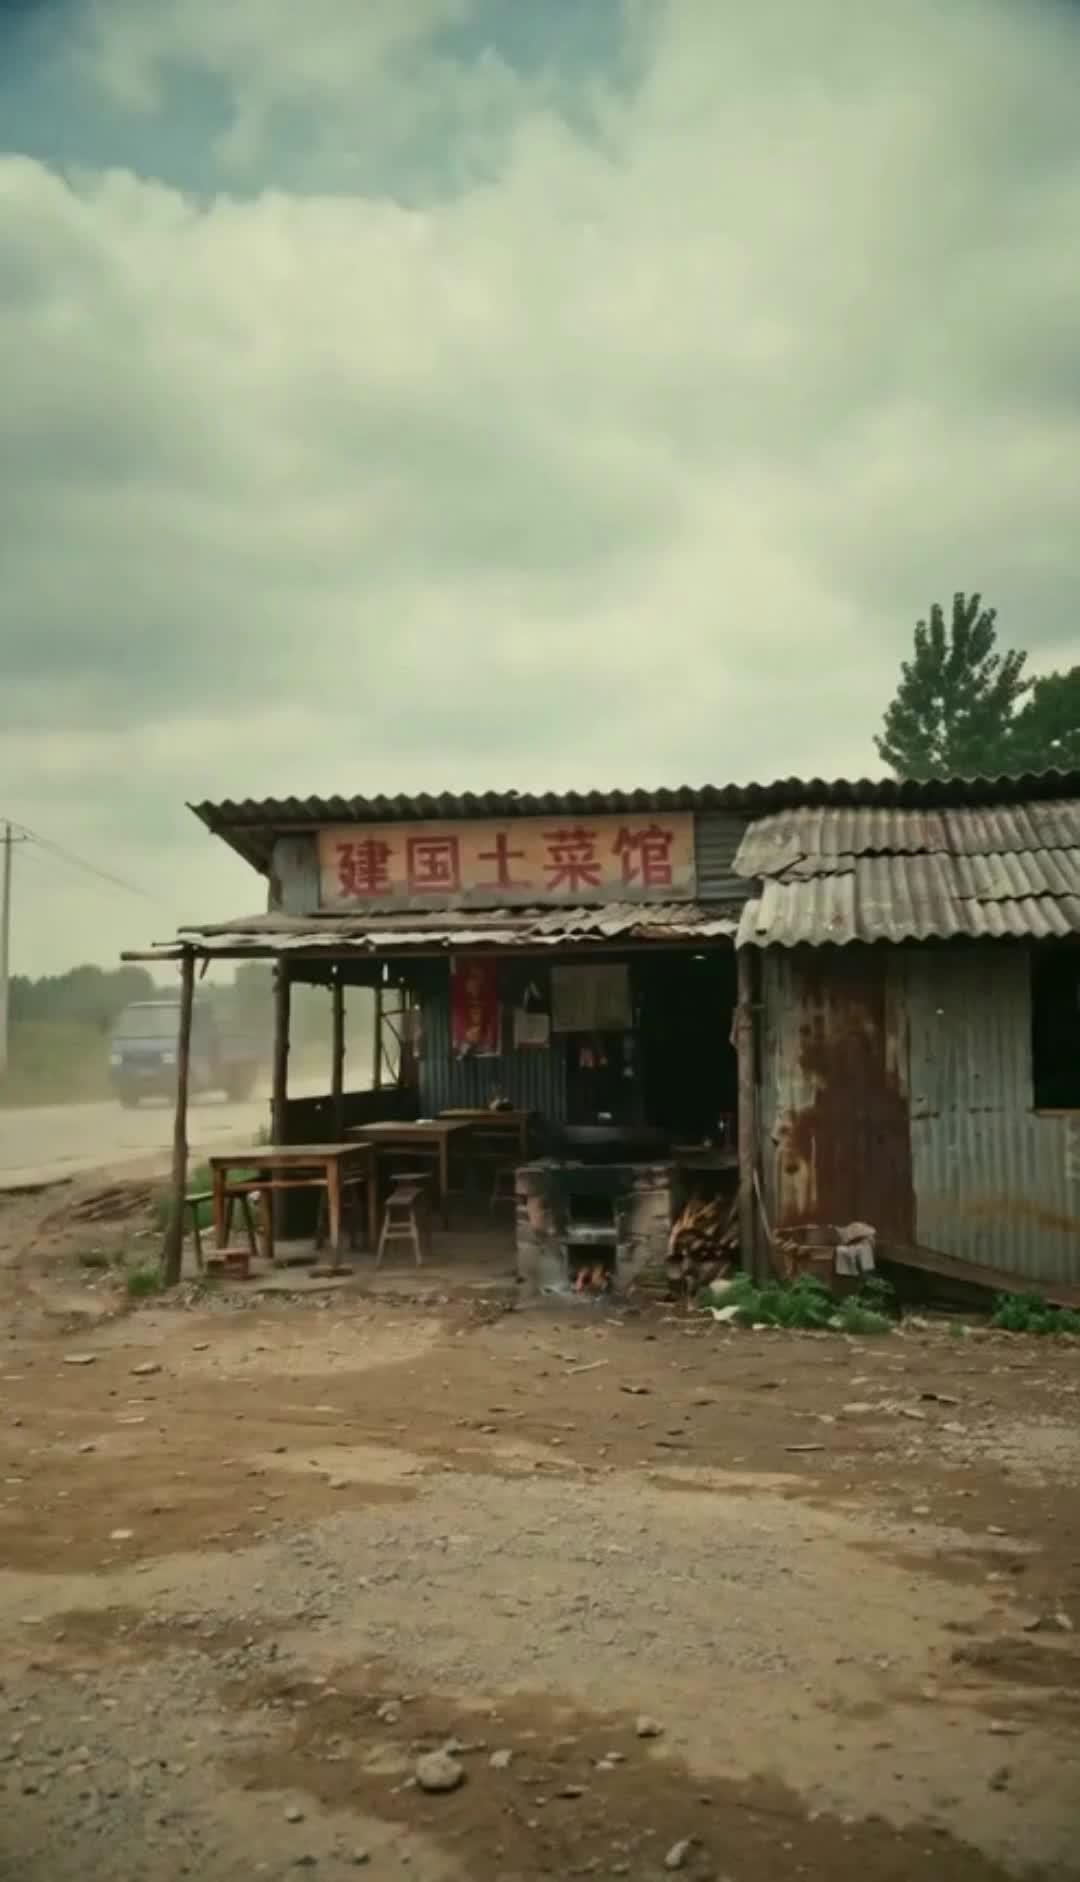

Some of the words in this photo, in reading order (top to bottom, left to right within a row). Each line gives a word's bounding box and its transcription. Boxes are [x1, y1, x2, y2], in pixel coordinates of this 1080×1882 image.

[335, 824, 674, 897] 建国土菜馆
